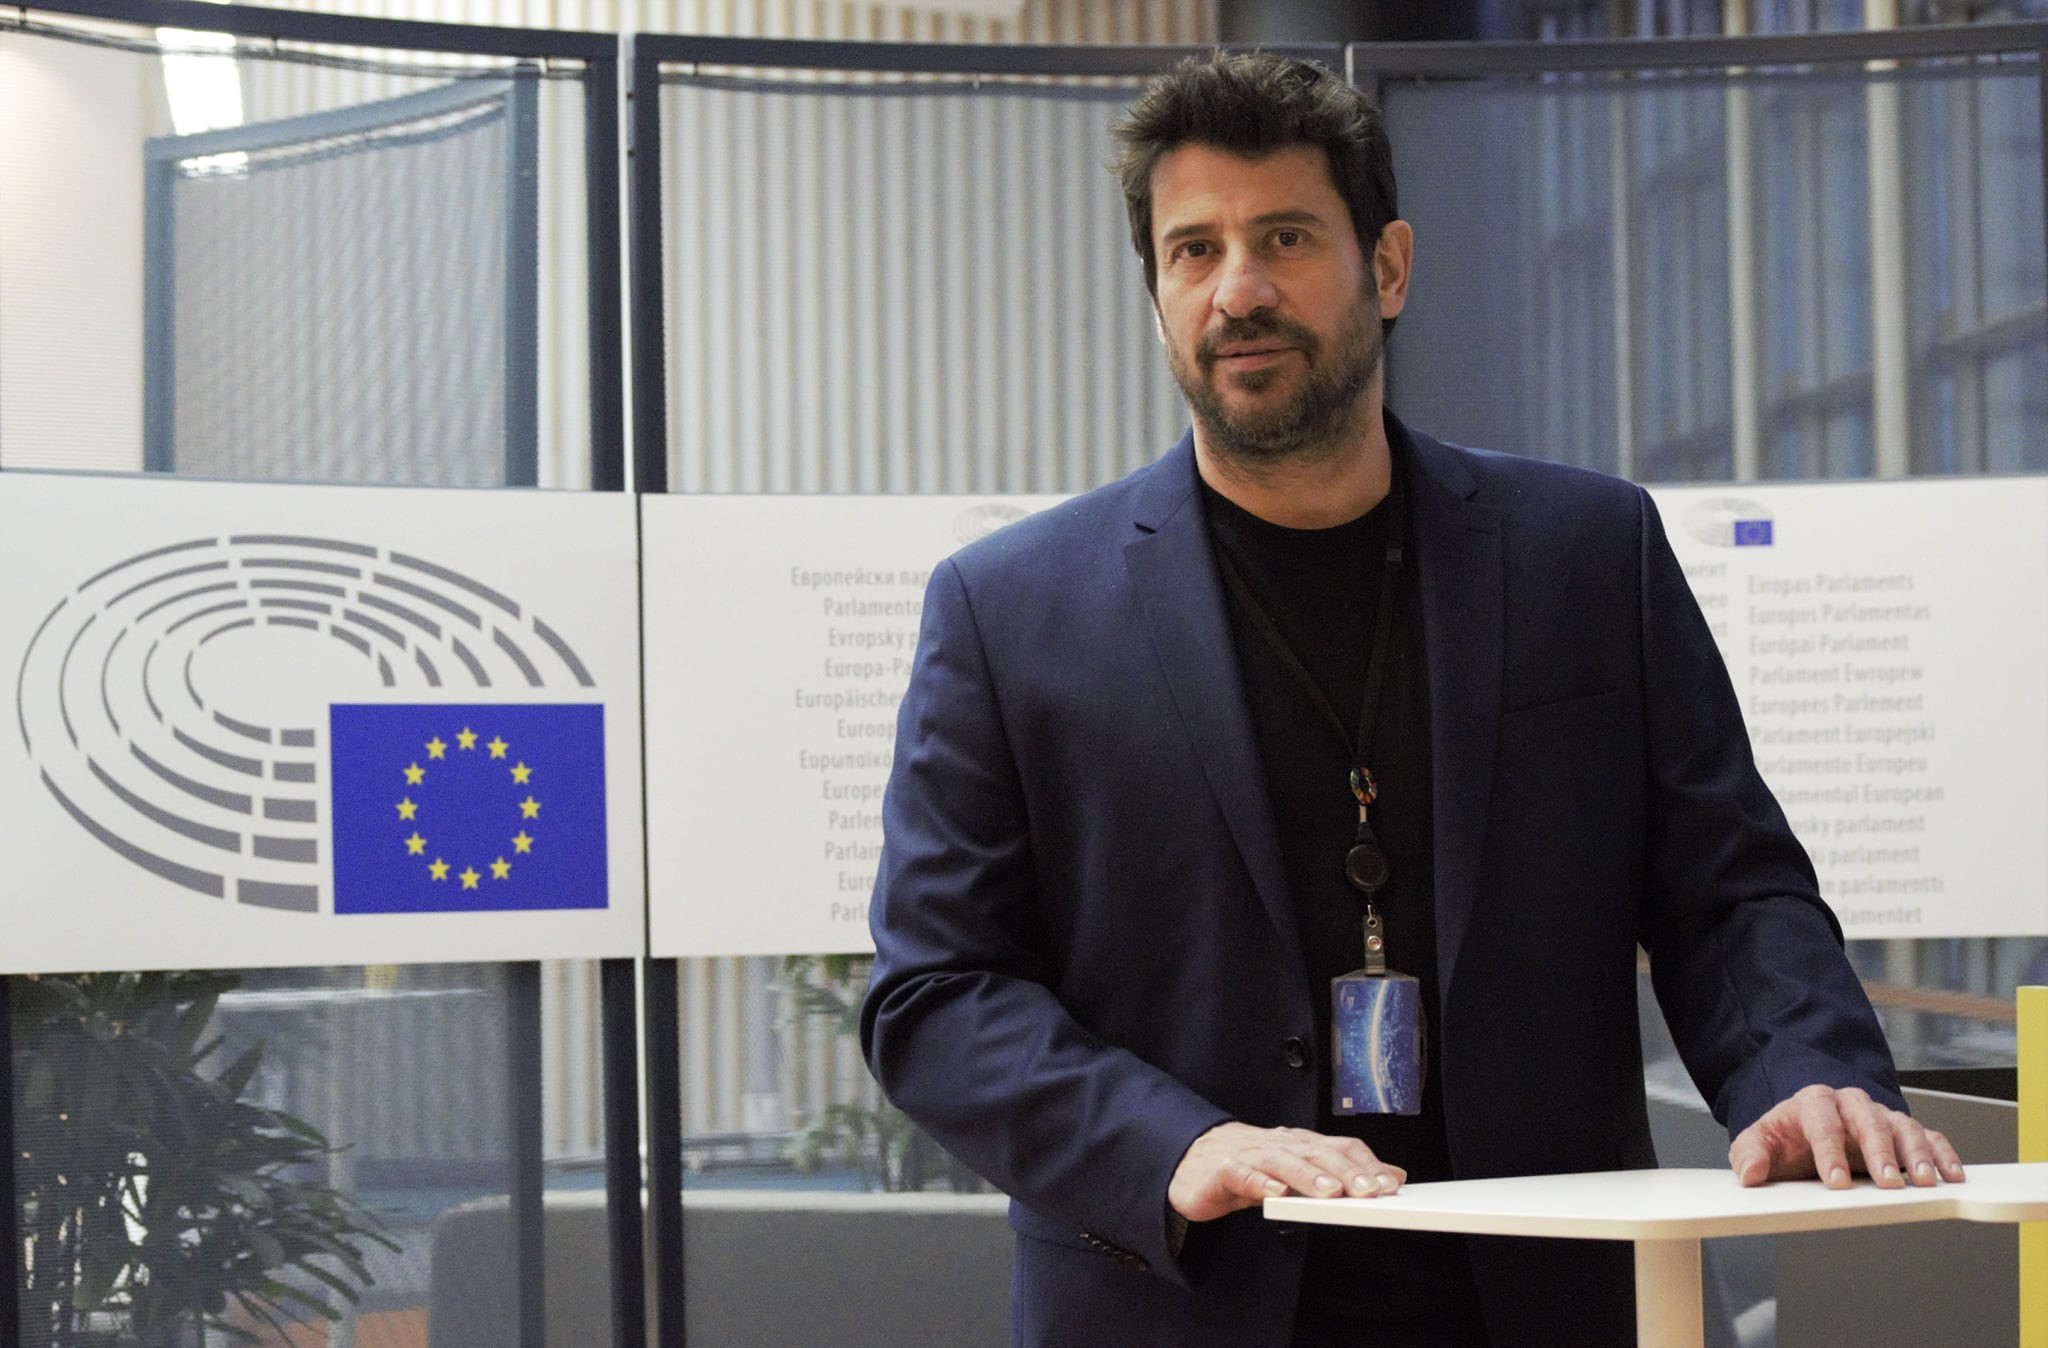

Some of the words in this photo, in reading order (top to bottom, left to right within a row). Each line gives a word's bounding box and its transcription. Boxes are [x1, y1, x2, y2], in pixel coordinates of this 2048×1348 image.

[791, 566, 895, 590] Европейски
[1747, 574, 1811, 597] Eiropas
[1815, 573, 1915, 593] Parlaments
[823, 597, 923, 616] Parlamento
[1748, 605, 1818, 627] Europos
[1822, 604, 1932, 624] Parlamentas
[828, 627, 905, 650] Evropský
[1748, 634, 1815, 657] Európai
[1819, 633, 1910, 654] Parlament
[1748, 665, 1840, 686] Parlament
[1844, 663, 1924, 687] Ewropew
[1748, 695, 1828, 718] Europees
[1833, 694, 1924, 714] Parlement
[1751, 726, 1841, 746] Parlament
[1845, 722, 1936, 748] Europejski
[1856, 754, 1929, 775] Europeu
[823, 780, 883, 803] Europe
[1862, 784, 1946, 806] European
[1836, 815, 1926, 837] parlament
[1829, 845, 1921, 867] parlament
[1839, 874, 1945, 898] parlamentti
